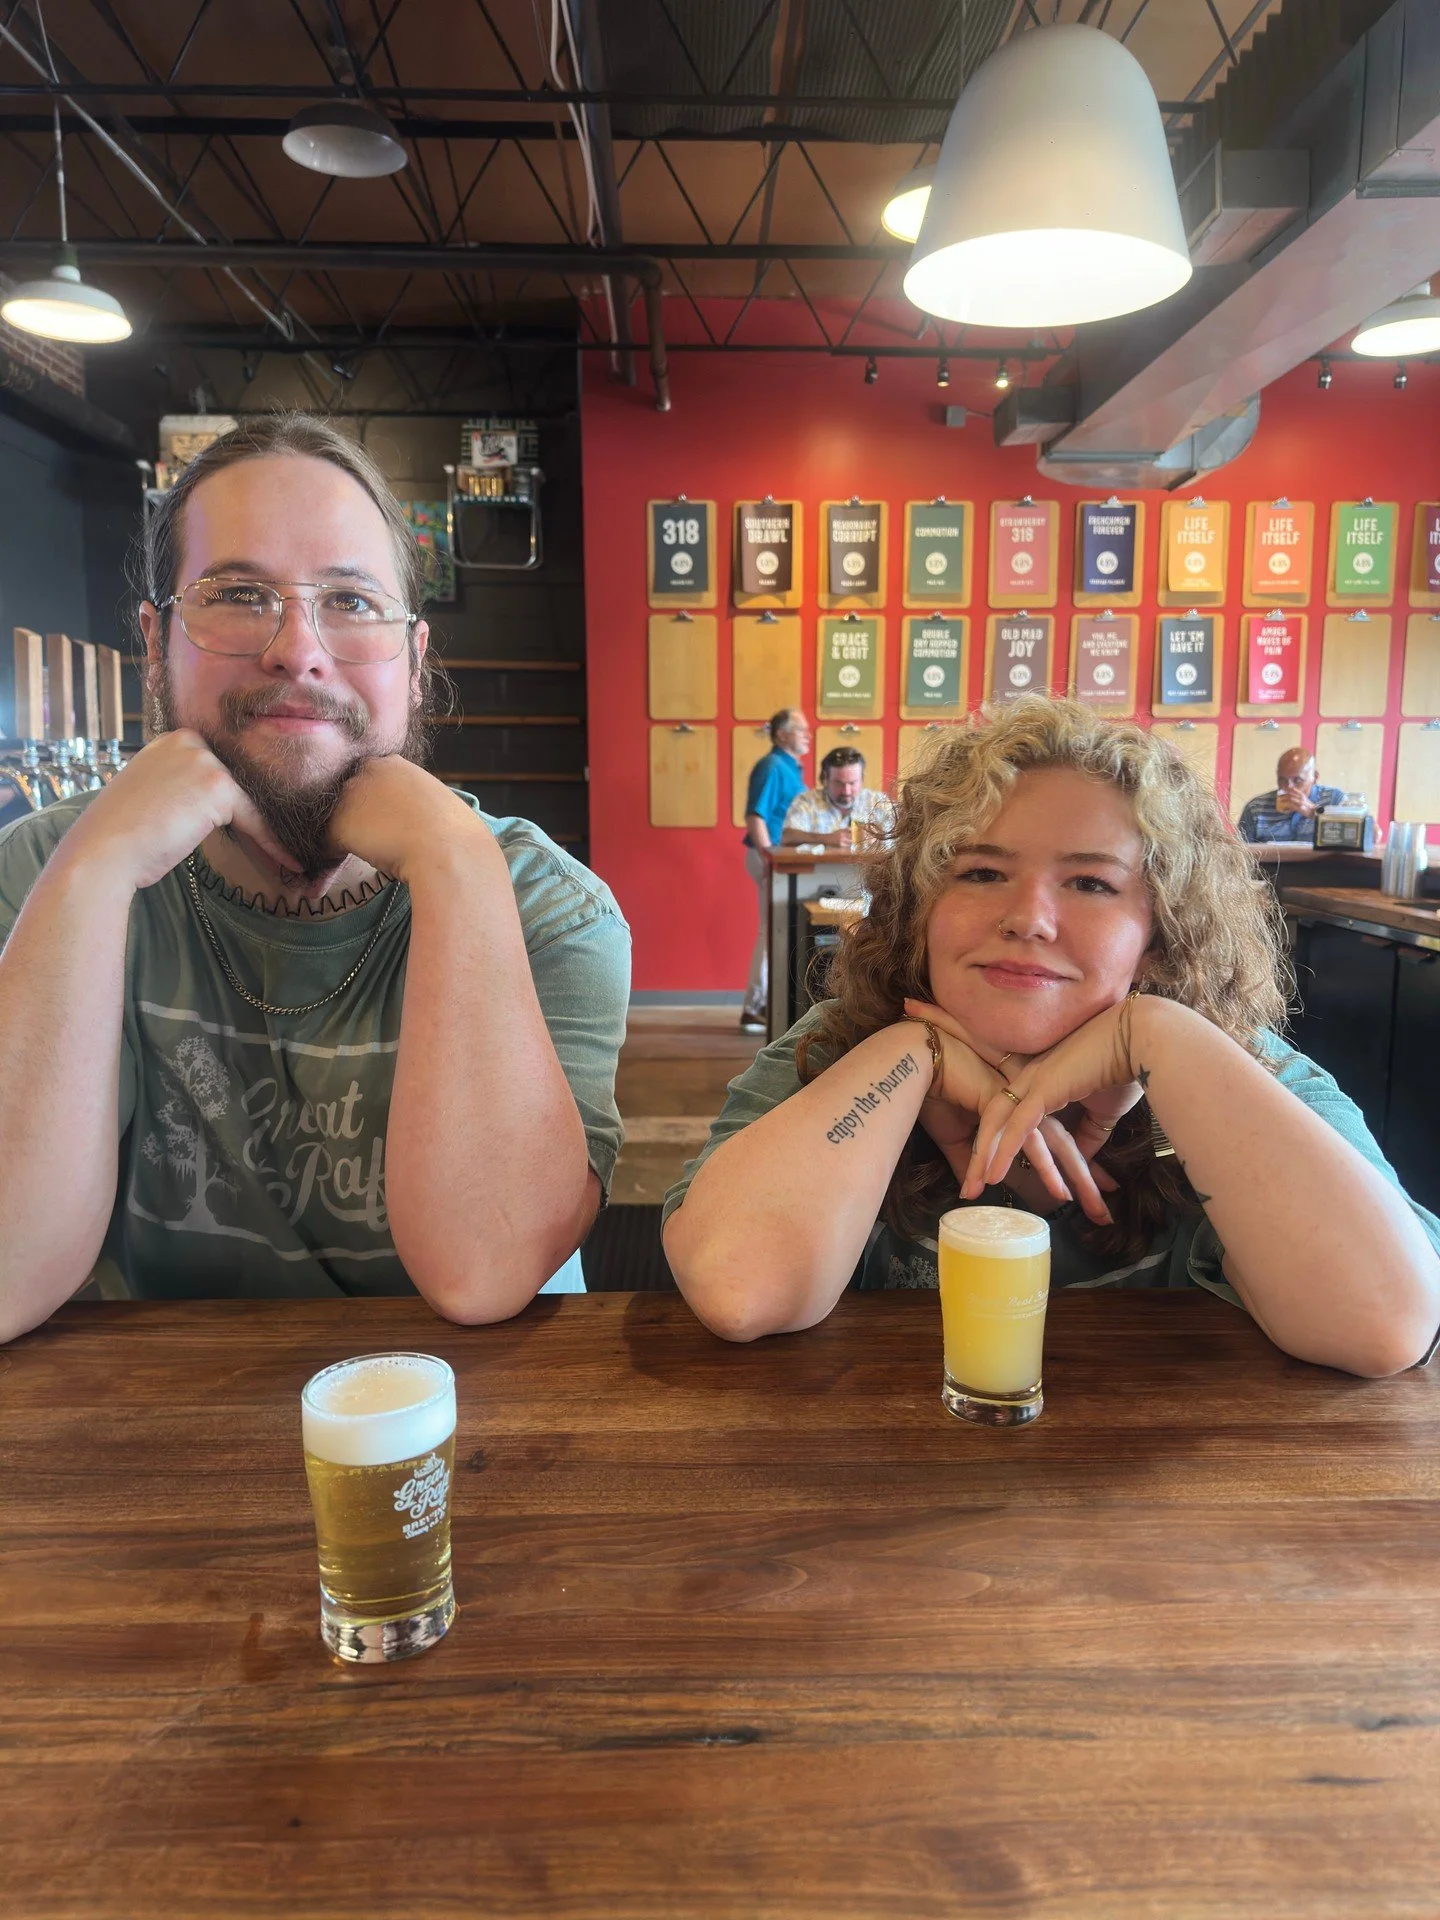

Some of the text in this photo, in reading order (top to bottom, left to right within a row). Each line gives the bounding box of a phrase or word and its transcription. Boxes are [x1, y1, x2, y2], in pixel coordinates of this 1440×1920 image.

[744, 516, 790, 530] SOUTHERN
[999, 517, 1046, 528] STRAWBERRY
[1088, 516, 1131, 527] FRENCHMEN
[1183, 516, 1209, 531] LIFE
[1268, 517, 1294, 532] LIFE
[1353, 517, 1378, 532] LIFE
[662, 518, 700, 545] 318
[832, 530, 877, 544] CORRUPT
[915, 526, 960, 538] COMMOTION
[1010, 527, 1034, 543] 318
[1092, 526, 1125, 536] FOREVER
[1177, 530, 1216, 545] ITSELF
[1261, 531, 1300, 546] ITSELF
[1346, 531, 1384, 546] ITSELF
[921, 629, 951, 639] DOUBLE
[1001, 628, 1044, 641] OLD MAD
[1169, 630, 1186, 643] LET
[1260, 626, 1287, 636] AMBER
[832, 632, 869, 647] GRACE
[913, 639, 958, 649] DRY HOPPED
[1082, 640, 1128, 649] AND EVERYONE
[1256, 636, 1292, 646] WAVES OF
[831, 646, 869, 660] & GRIT
[912, 648, 957, 659] COMMOTION
[1008, 640, 1036, 658] JOY
[1090, 648, 1101, 657] WE
[1169, 642, 1205, 653] HAVE IT
[1264, 646, 1282, 656] PAIN
[827, 1053, 919, 1145] enjoy the journey
[241, 1077, 364, 1174] Great
[266, 1136, 391, 1232] Raf
[393, 1459, 445, 1511] Great
